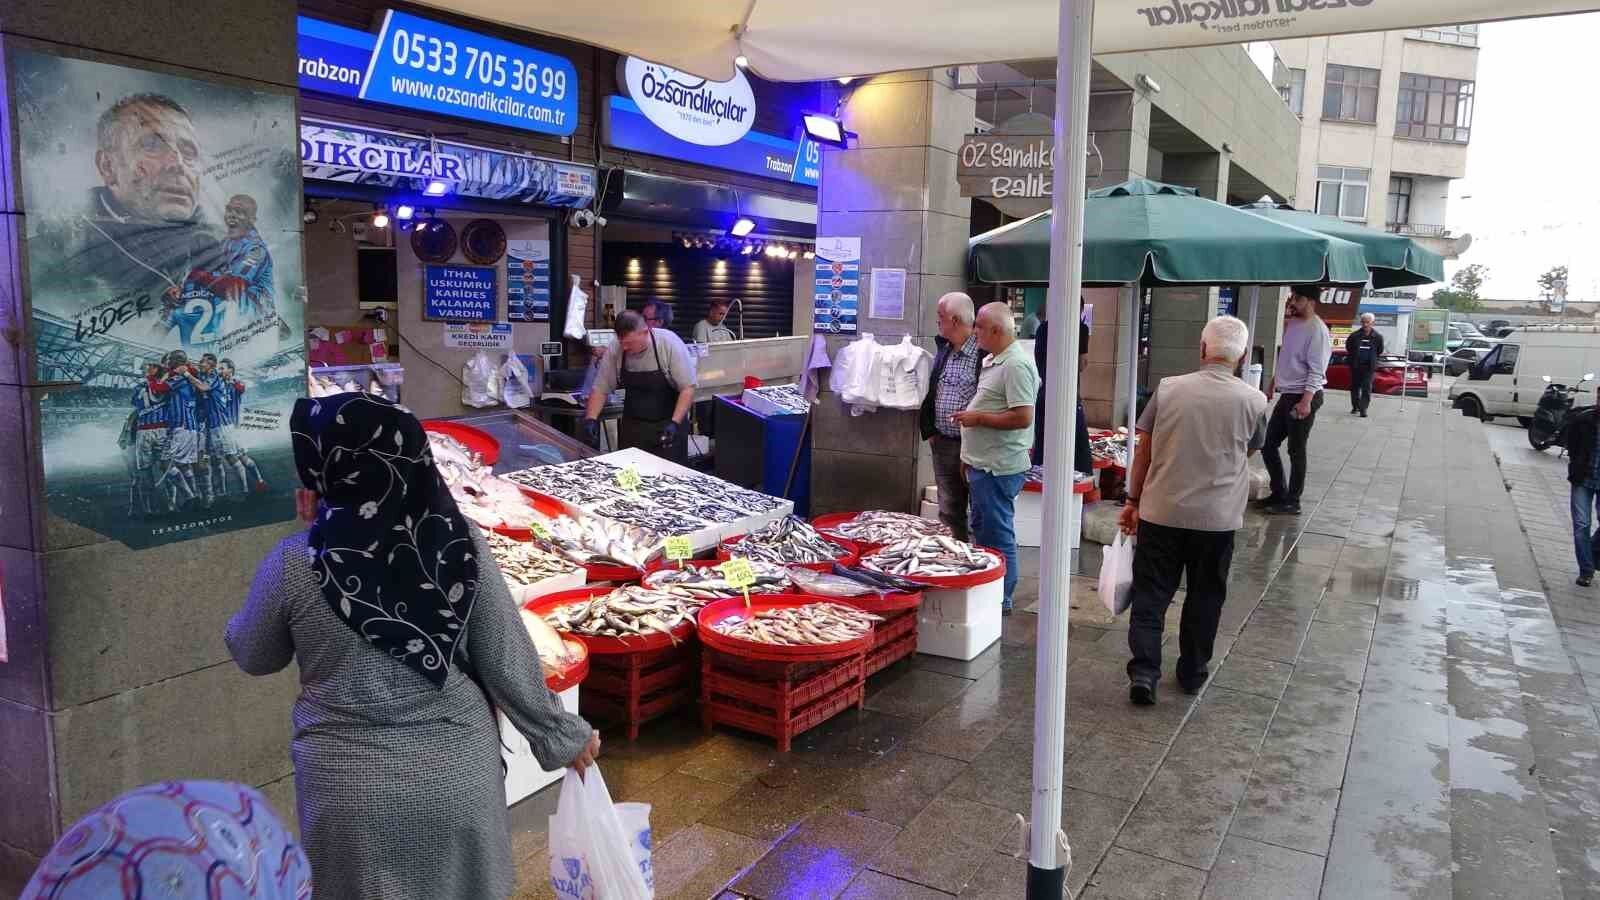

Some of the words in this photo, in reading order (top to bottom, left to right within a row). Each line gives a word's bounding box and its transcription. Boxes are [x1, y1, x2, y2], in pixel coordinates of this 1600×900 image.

[392, 29, 457, 76] 0533
[465, 46, 507, 88] 705
[511, 59, 538, 95] 36
[541, 66, 566, 101] 99
[391, 75, 566, 126] www.ozsandikcilar.com.tr
[641, 65, 748, 124] Özsandıkçılar
[806, 141, 819, 163] 05
[766, 156, 793, 174] Trabzon
[990, 173, 1053, 198] Balık
[430, 279, 492, 289] USKUMRU
[435, 289, 487, 299] KARİDES
[431, 299, 491, 309] KALAMAR
